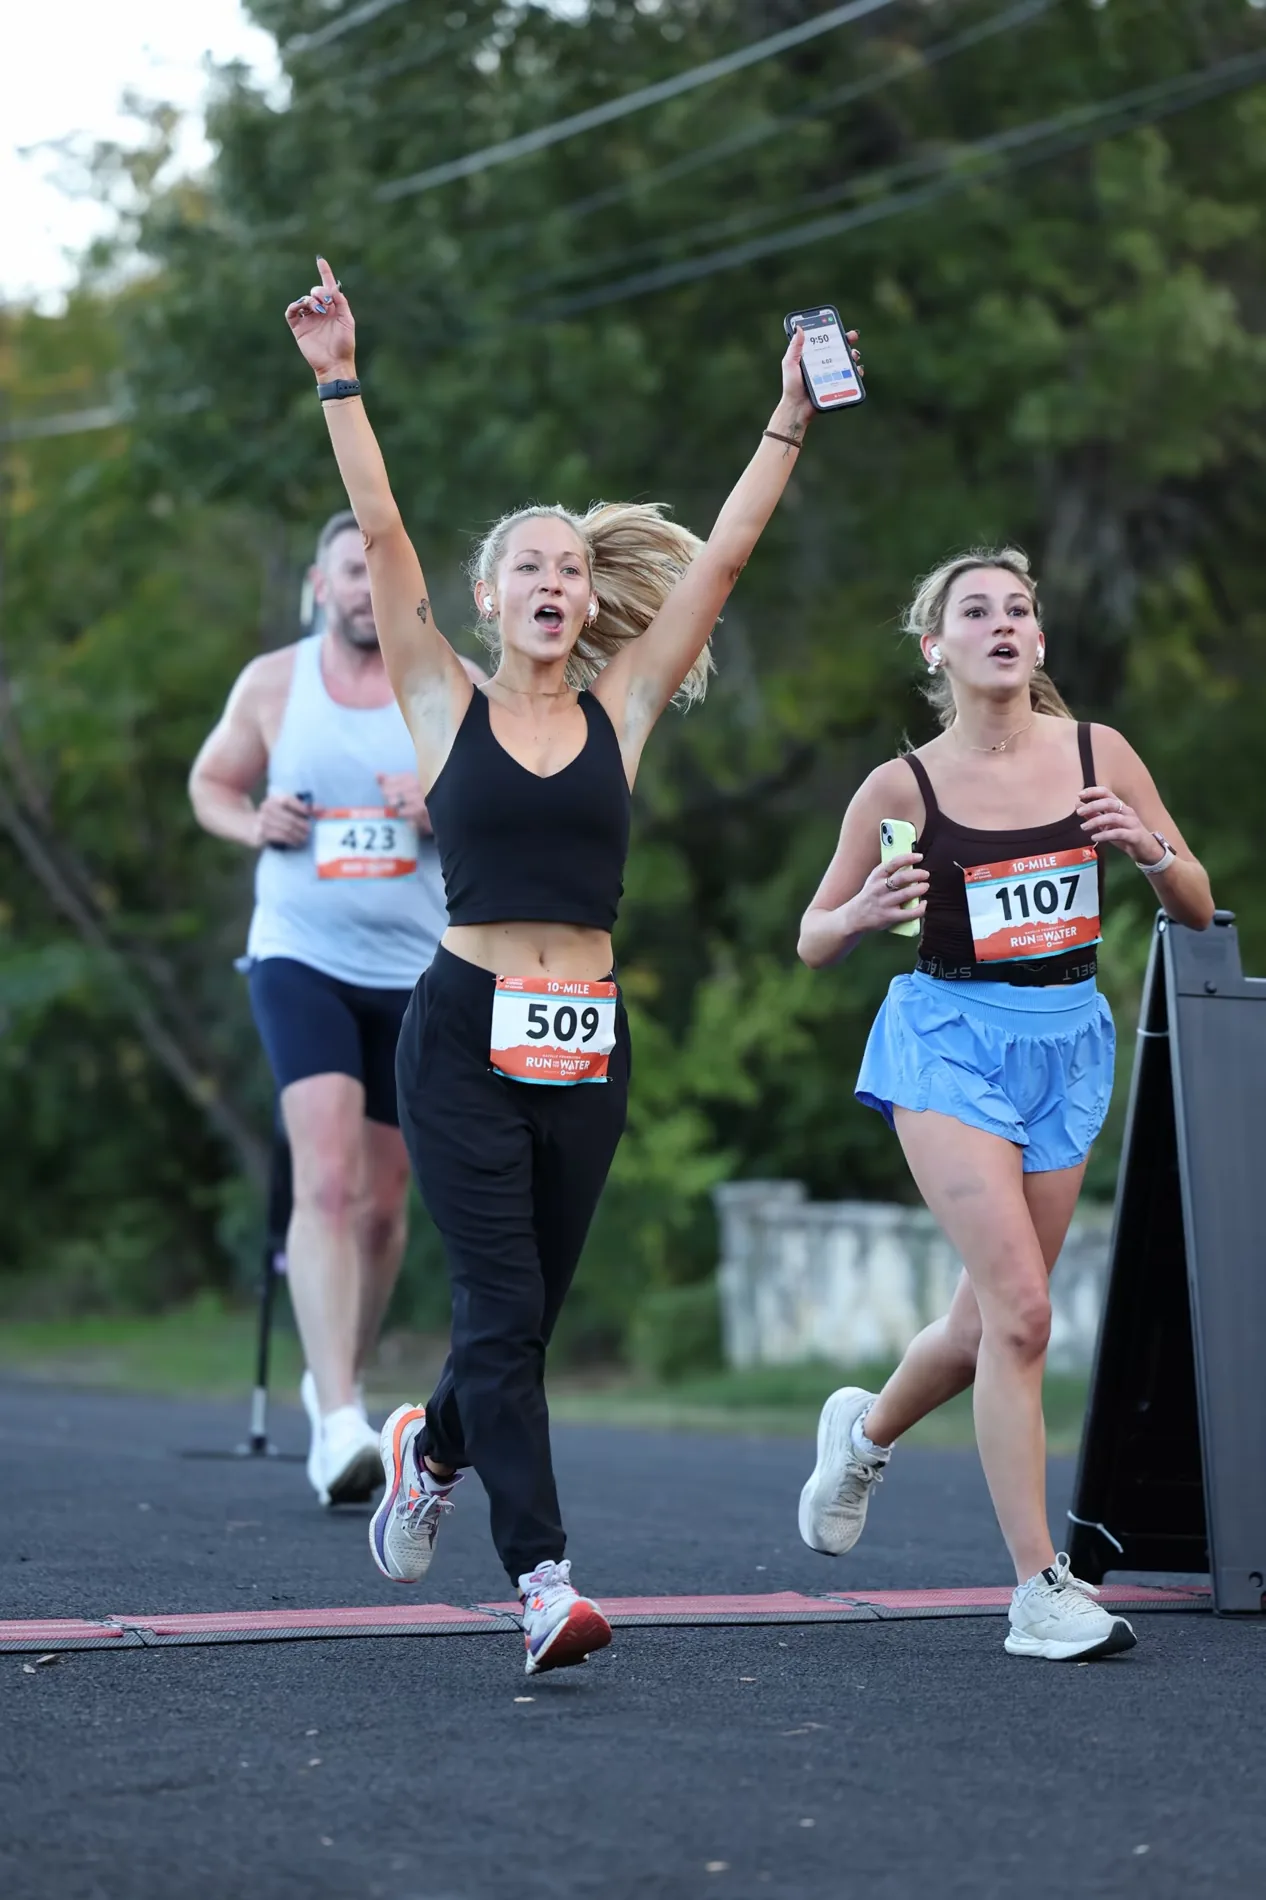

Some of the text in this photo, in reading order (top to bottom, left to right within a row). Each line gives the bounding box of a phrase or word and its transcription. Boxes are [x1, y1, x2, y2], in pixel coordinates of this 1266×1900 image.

[810, 334, 830, 345] 9:50
[341, 824, 396, 852] 423
[1012, 856, 1057, 873] 10-MILE
[995, 874, 1080, 921] 1107
[1010, 933, 1036, 948] RUN
[1043, 926, 1077, 941] WATER
[547, 982, 590, 994] 10-MILE
[526, 1003, 599, 1043] 509
[526, 1056, 552, 1069] RUN
[560, 1059, 590, 1071] WATER
